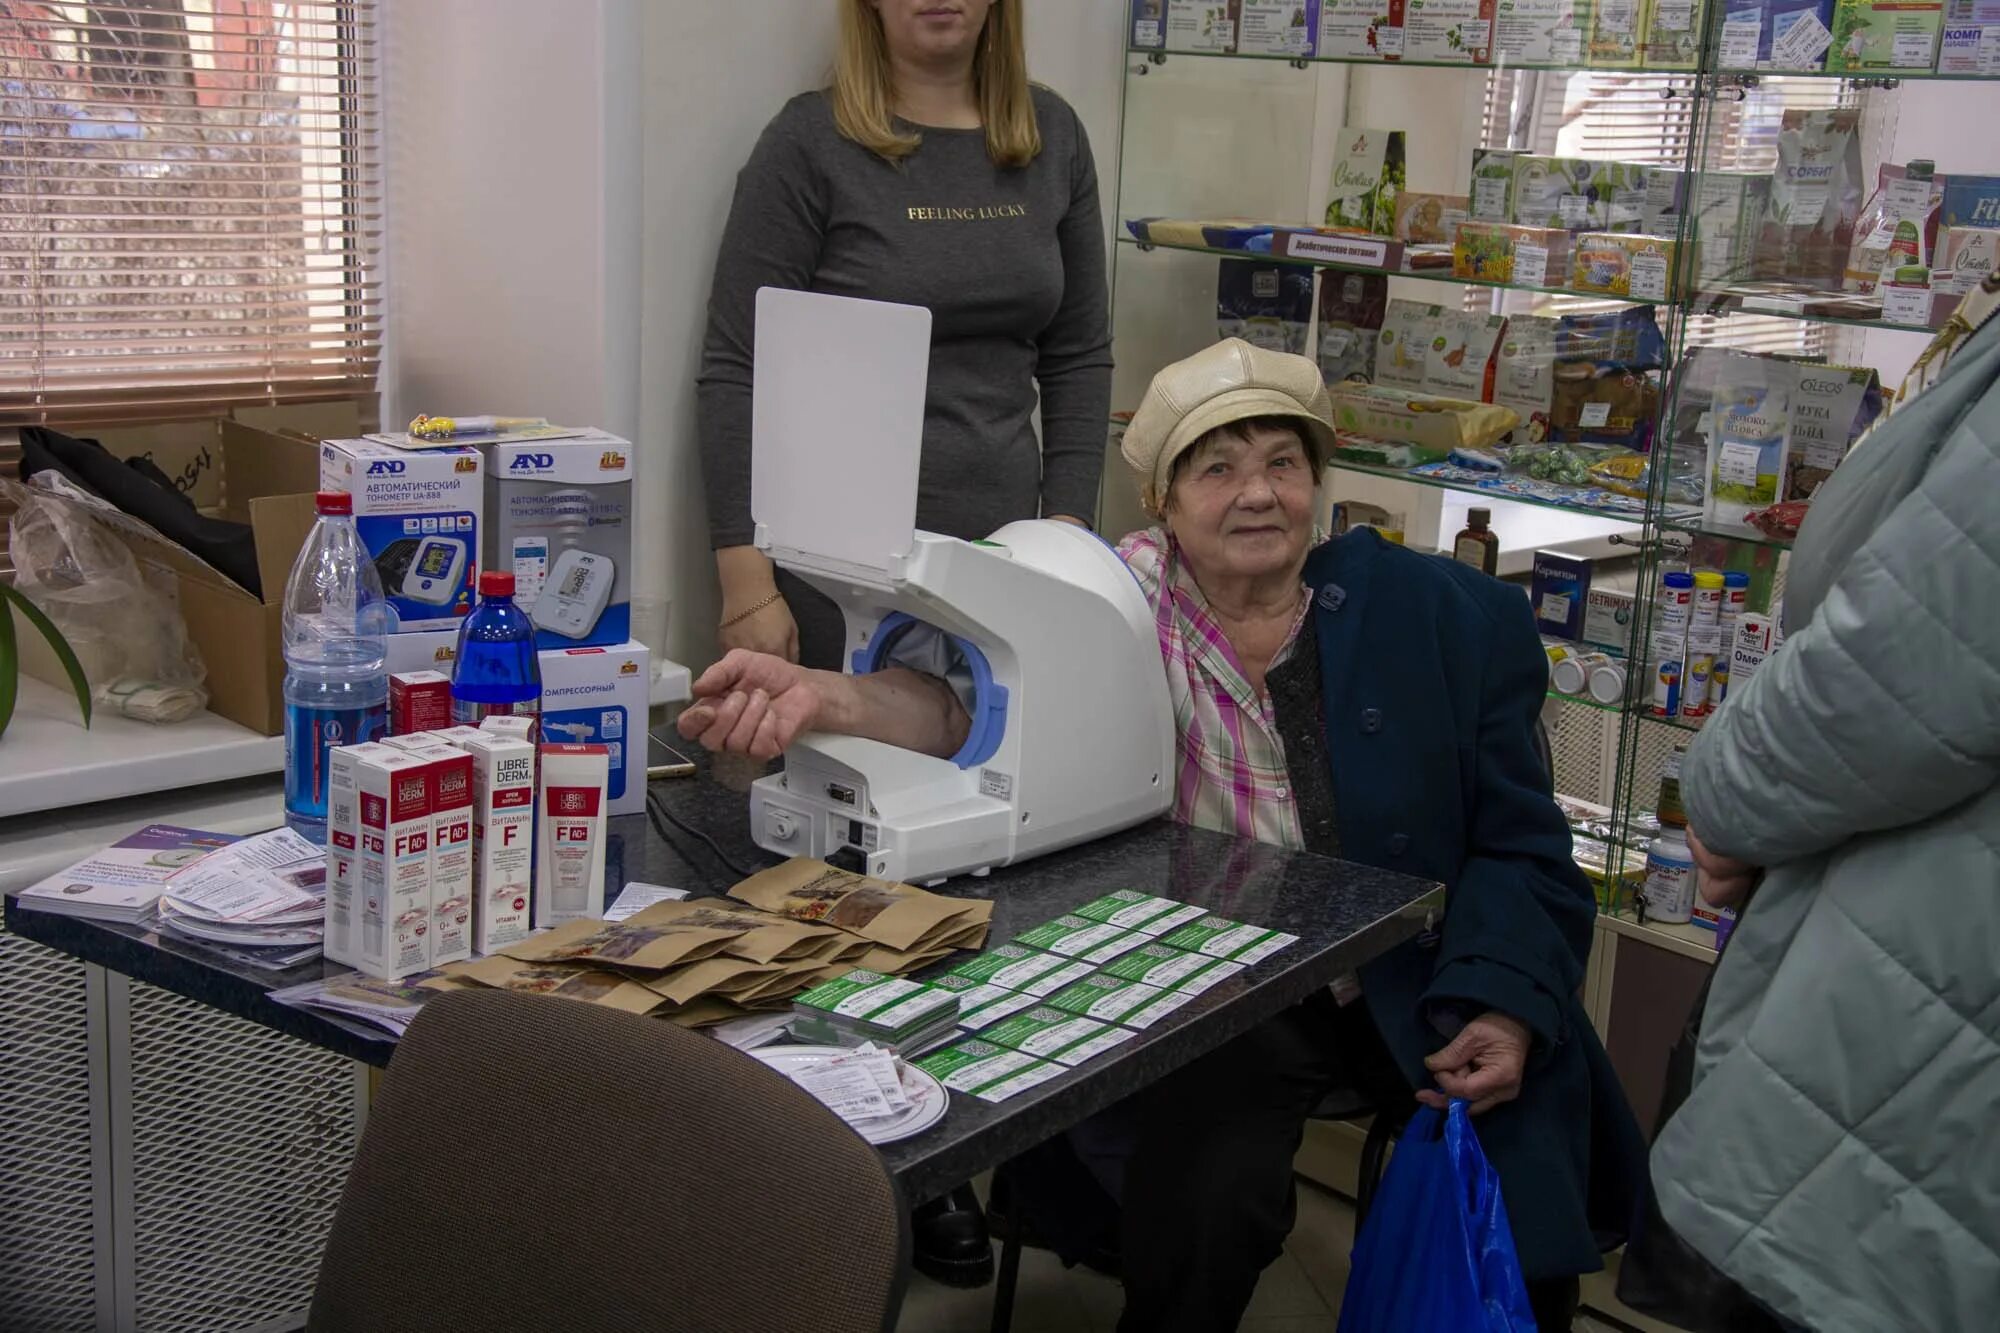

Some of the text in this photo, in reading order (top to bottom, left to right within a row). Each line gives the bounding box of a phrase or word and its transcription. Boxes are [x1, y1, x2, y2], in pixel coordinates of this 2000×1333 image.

[907, 203, 1026, 220] FEELING LUCKY
[1797, 405, 1831, 420] МУКА
[366, 479, 461, 493] АВТОМАТИЧЕСКИЙ
[366, 492, 411, 502] ТОНОМЕТР
[1588, 593, 1632, 609] DETRIMAX
[543, 682, 616, 697] ОМПРЕССОРНЫЙ
[497, 758, 529, 772] LIBRE
[497, 769, 528, 783] DERM
[440, 776, 467, 793] DERM
[399, 788, 425, 803] DERM
[435, 812, 470, 826] ВИТАМИН
[491, 815, 530, 826] ВИТАМИН
[395, 823, 428, 837] ВИТАМИН
[436, 826, 467, 847] F AD+
[503, 825, 518, 846] F
[557, 827, 568, 841] F
[363, 833, 371, 849] F
[395, 836, 426, 857] F AD+
[338, 862, 348, 878] F
